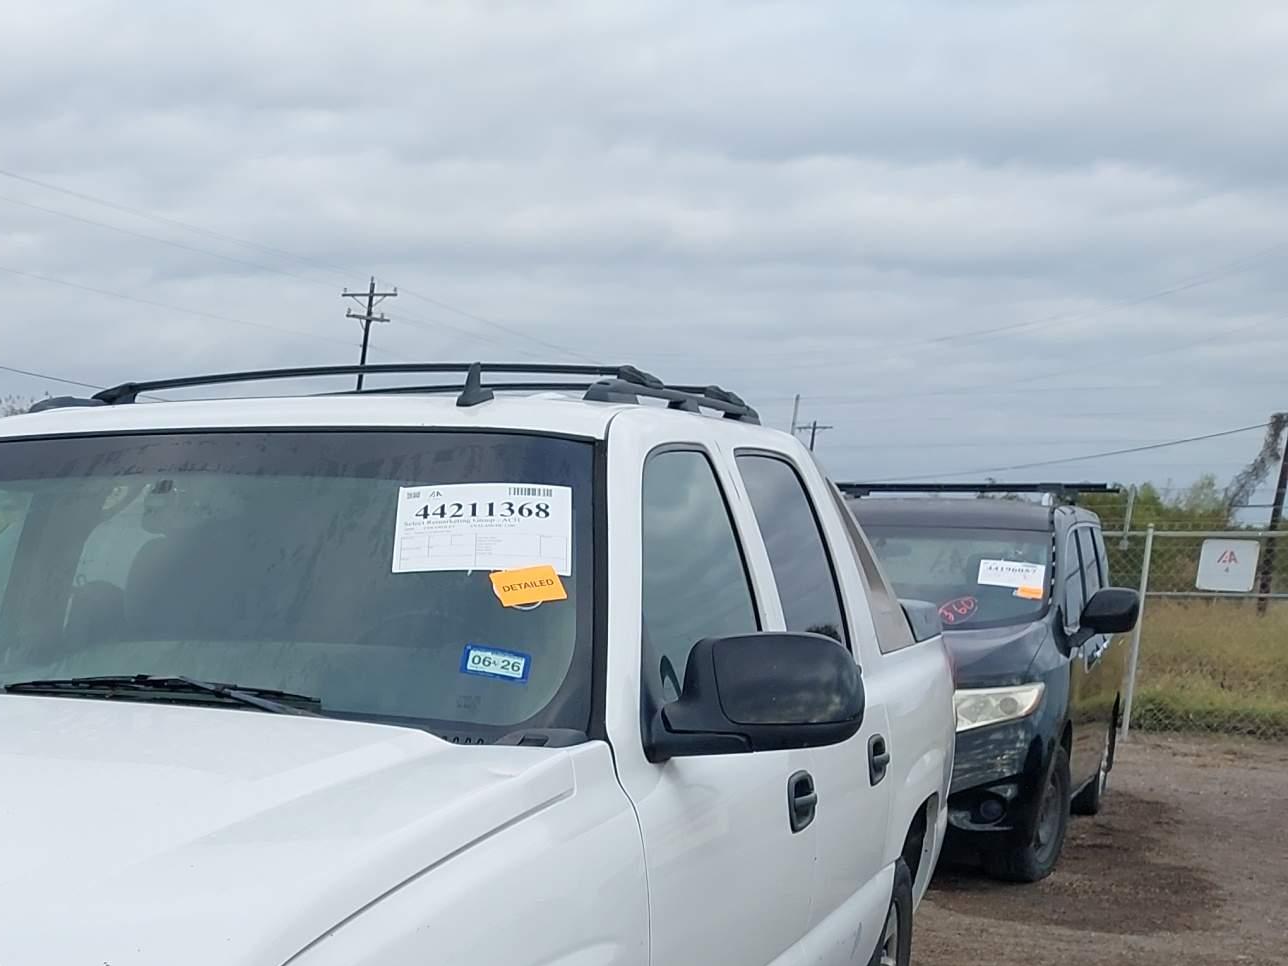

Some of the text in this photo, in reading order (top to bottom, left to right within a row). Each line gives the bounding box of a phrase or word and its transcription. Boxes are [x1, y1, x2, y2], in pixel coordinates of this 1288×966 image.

[415, 501, 550, 519] 44211368
[502, 578, 554, 593] DETAILED
[472, 655, 521, 672] 06 26
